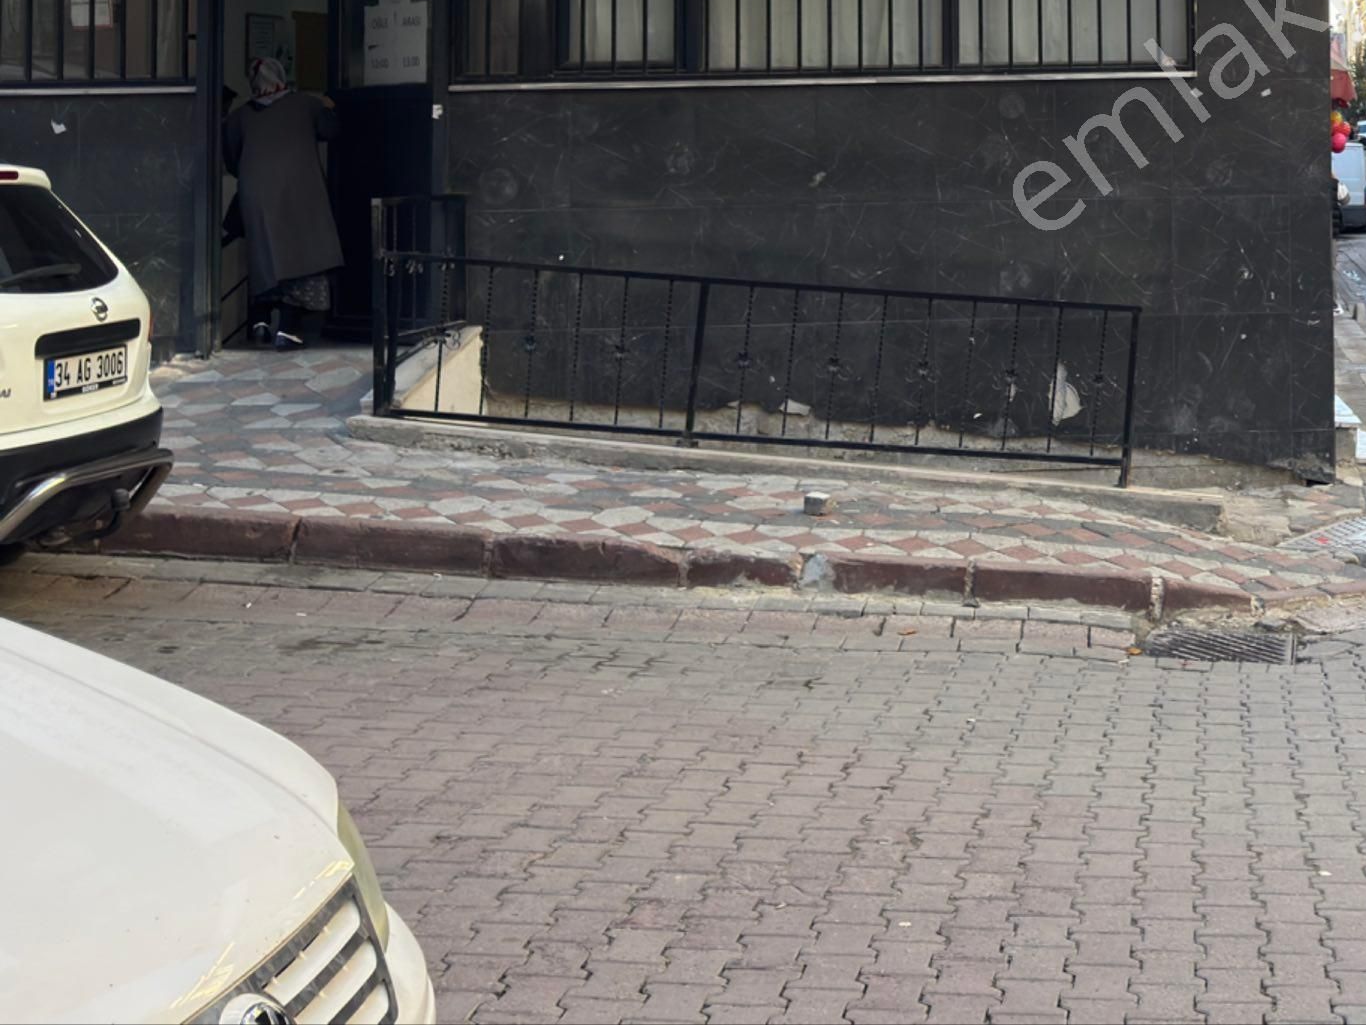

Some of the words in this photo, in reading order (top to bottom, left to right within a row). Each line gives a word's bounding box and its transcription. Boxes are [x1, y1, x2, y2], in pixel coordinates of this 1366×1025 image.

[55, 361, 71, 387] 34
[76, 357, 91, 384] AG
[96, 351, 123, 379] 3006
